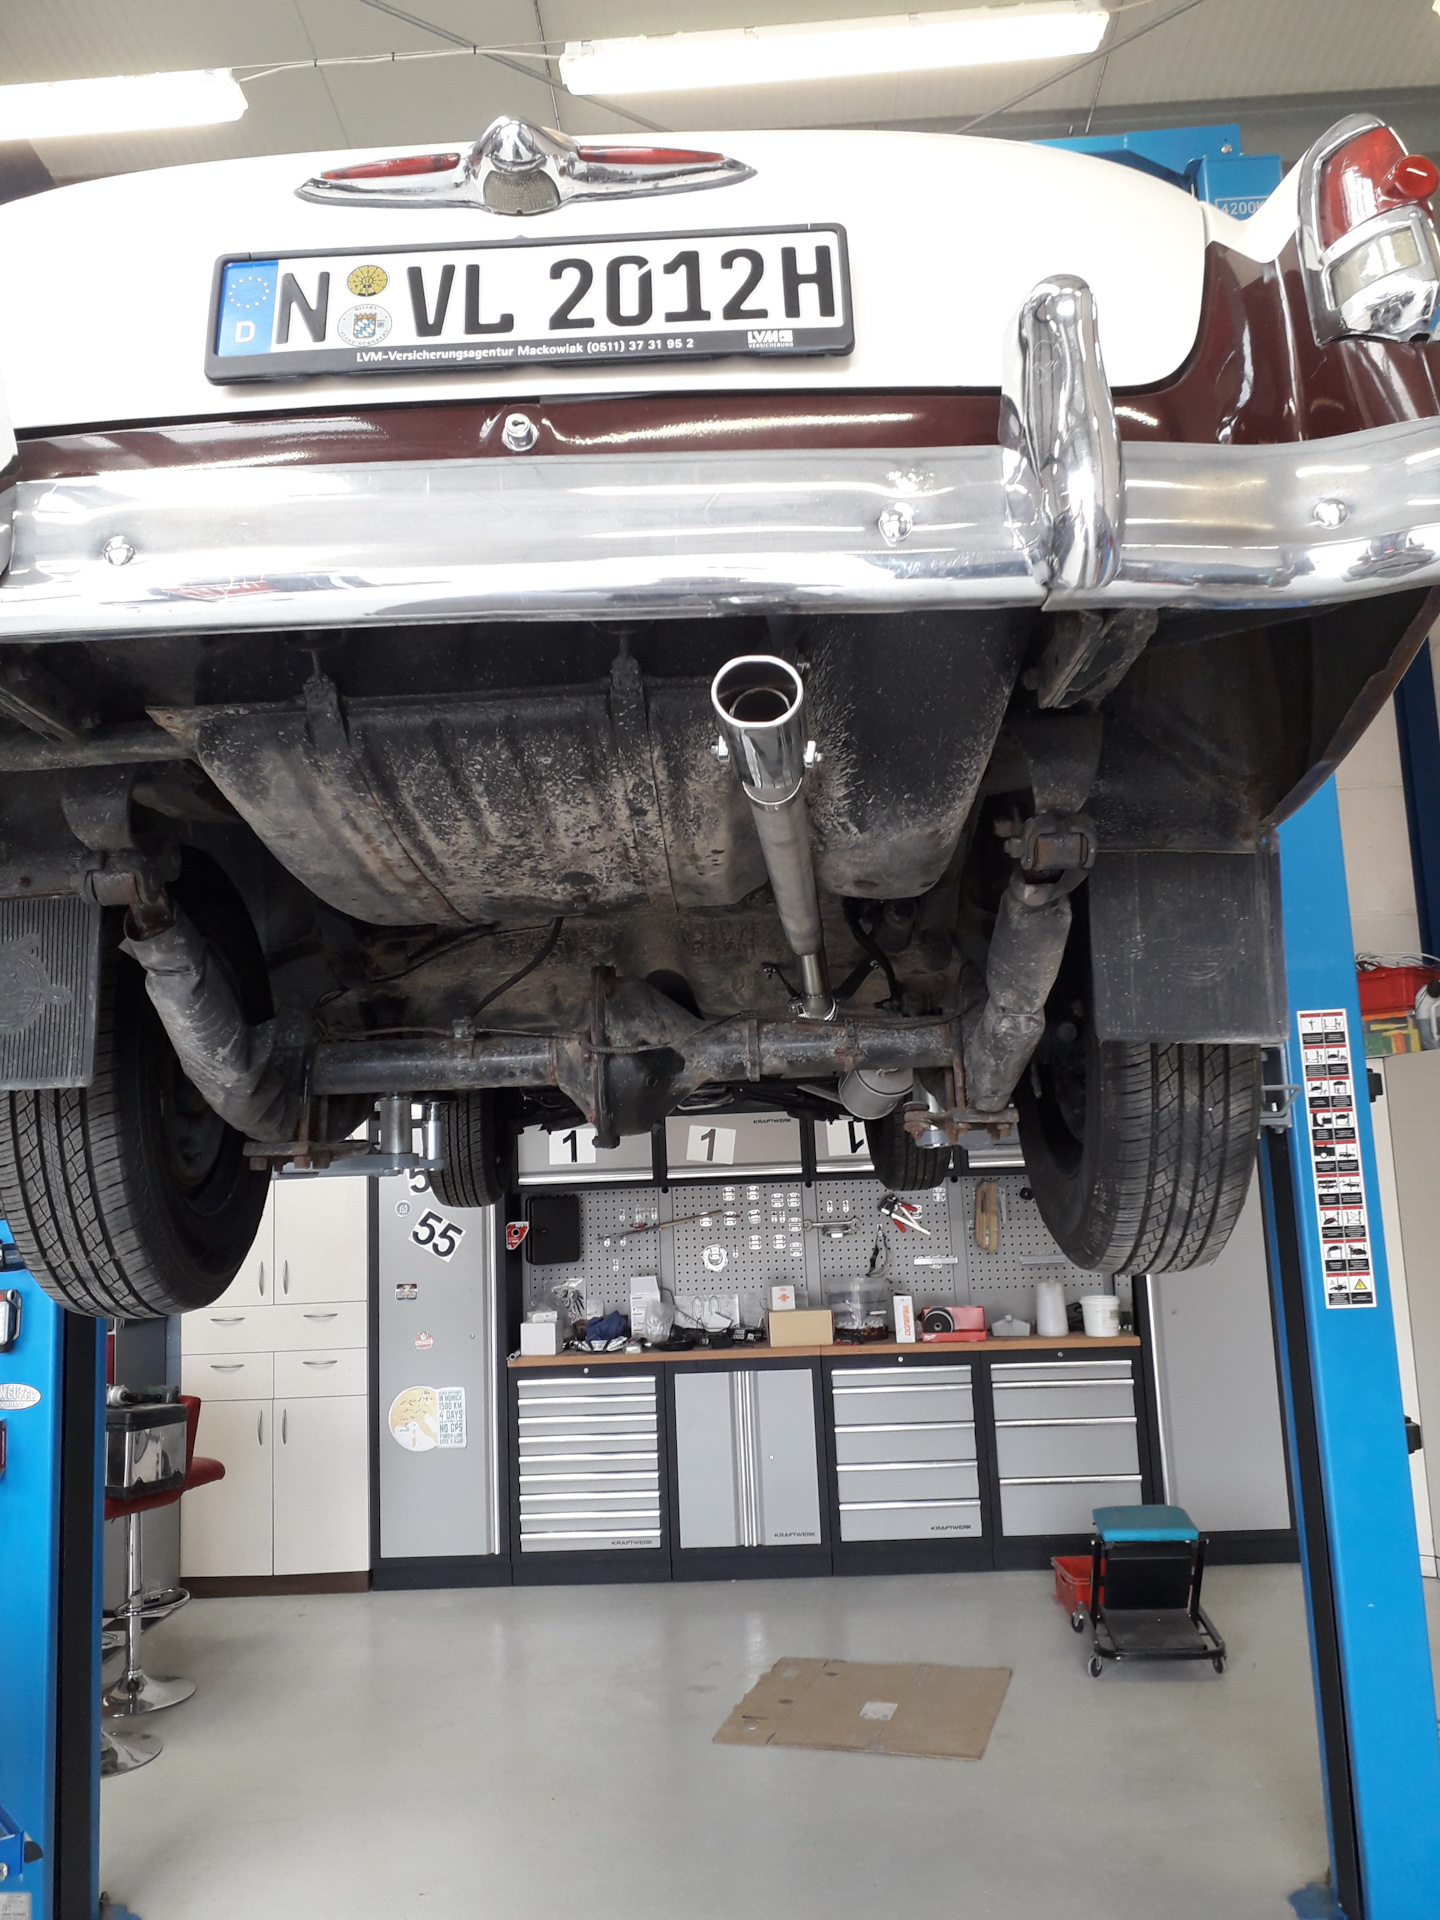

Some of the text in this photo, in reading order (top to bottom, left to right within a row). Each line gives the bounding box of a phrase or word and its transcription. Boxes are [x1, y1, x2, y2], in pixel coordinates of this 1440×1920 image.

[275, 245, 835, 344] N VL 2012H
[234, 321, 255, 343] D
[747, 330, 779, 344] LVM
[356, 347, 514, 362] LVM-Versicherungsagentur
[587, 340, 625, 354] (0511)
[628, 340, 644, 351] 37
[647, 339, 662, 350] 31
[666, 338, 683, 349] 95
[686, 337, 694, 348] 2
[562, 1129, 578, 1163] 1
[700, 1128, 716, 1162] 1
[412, 1210, 464, 1257] 55
[446, 1410, 463, 1420] DAYS
[439, 1423, 463, 1433] NO GPS
